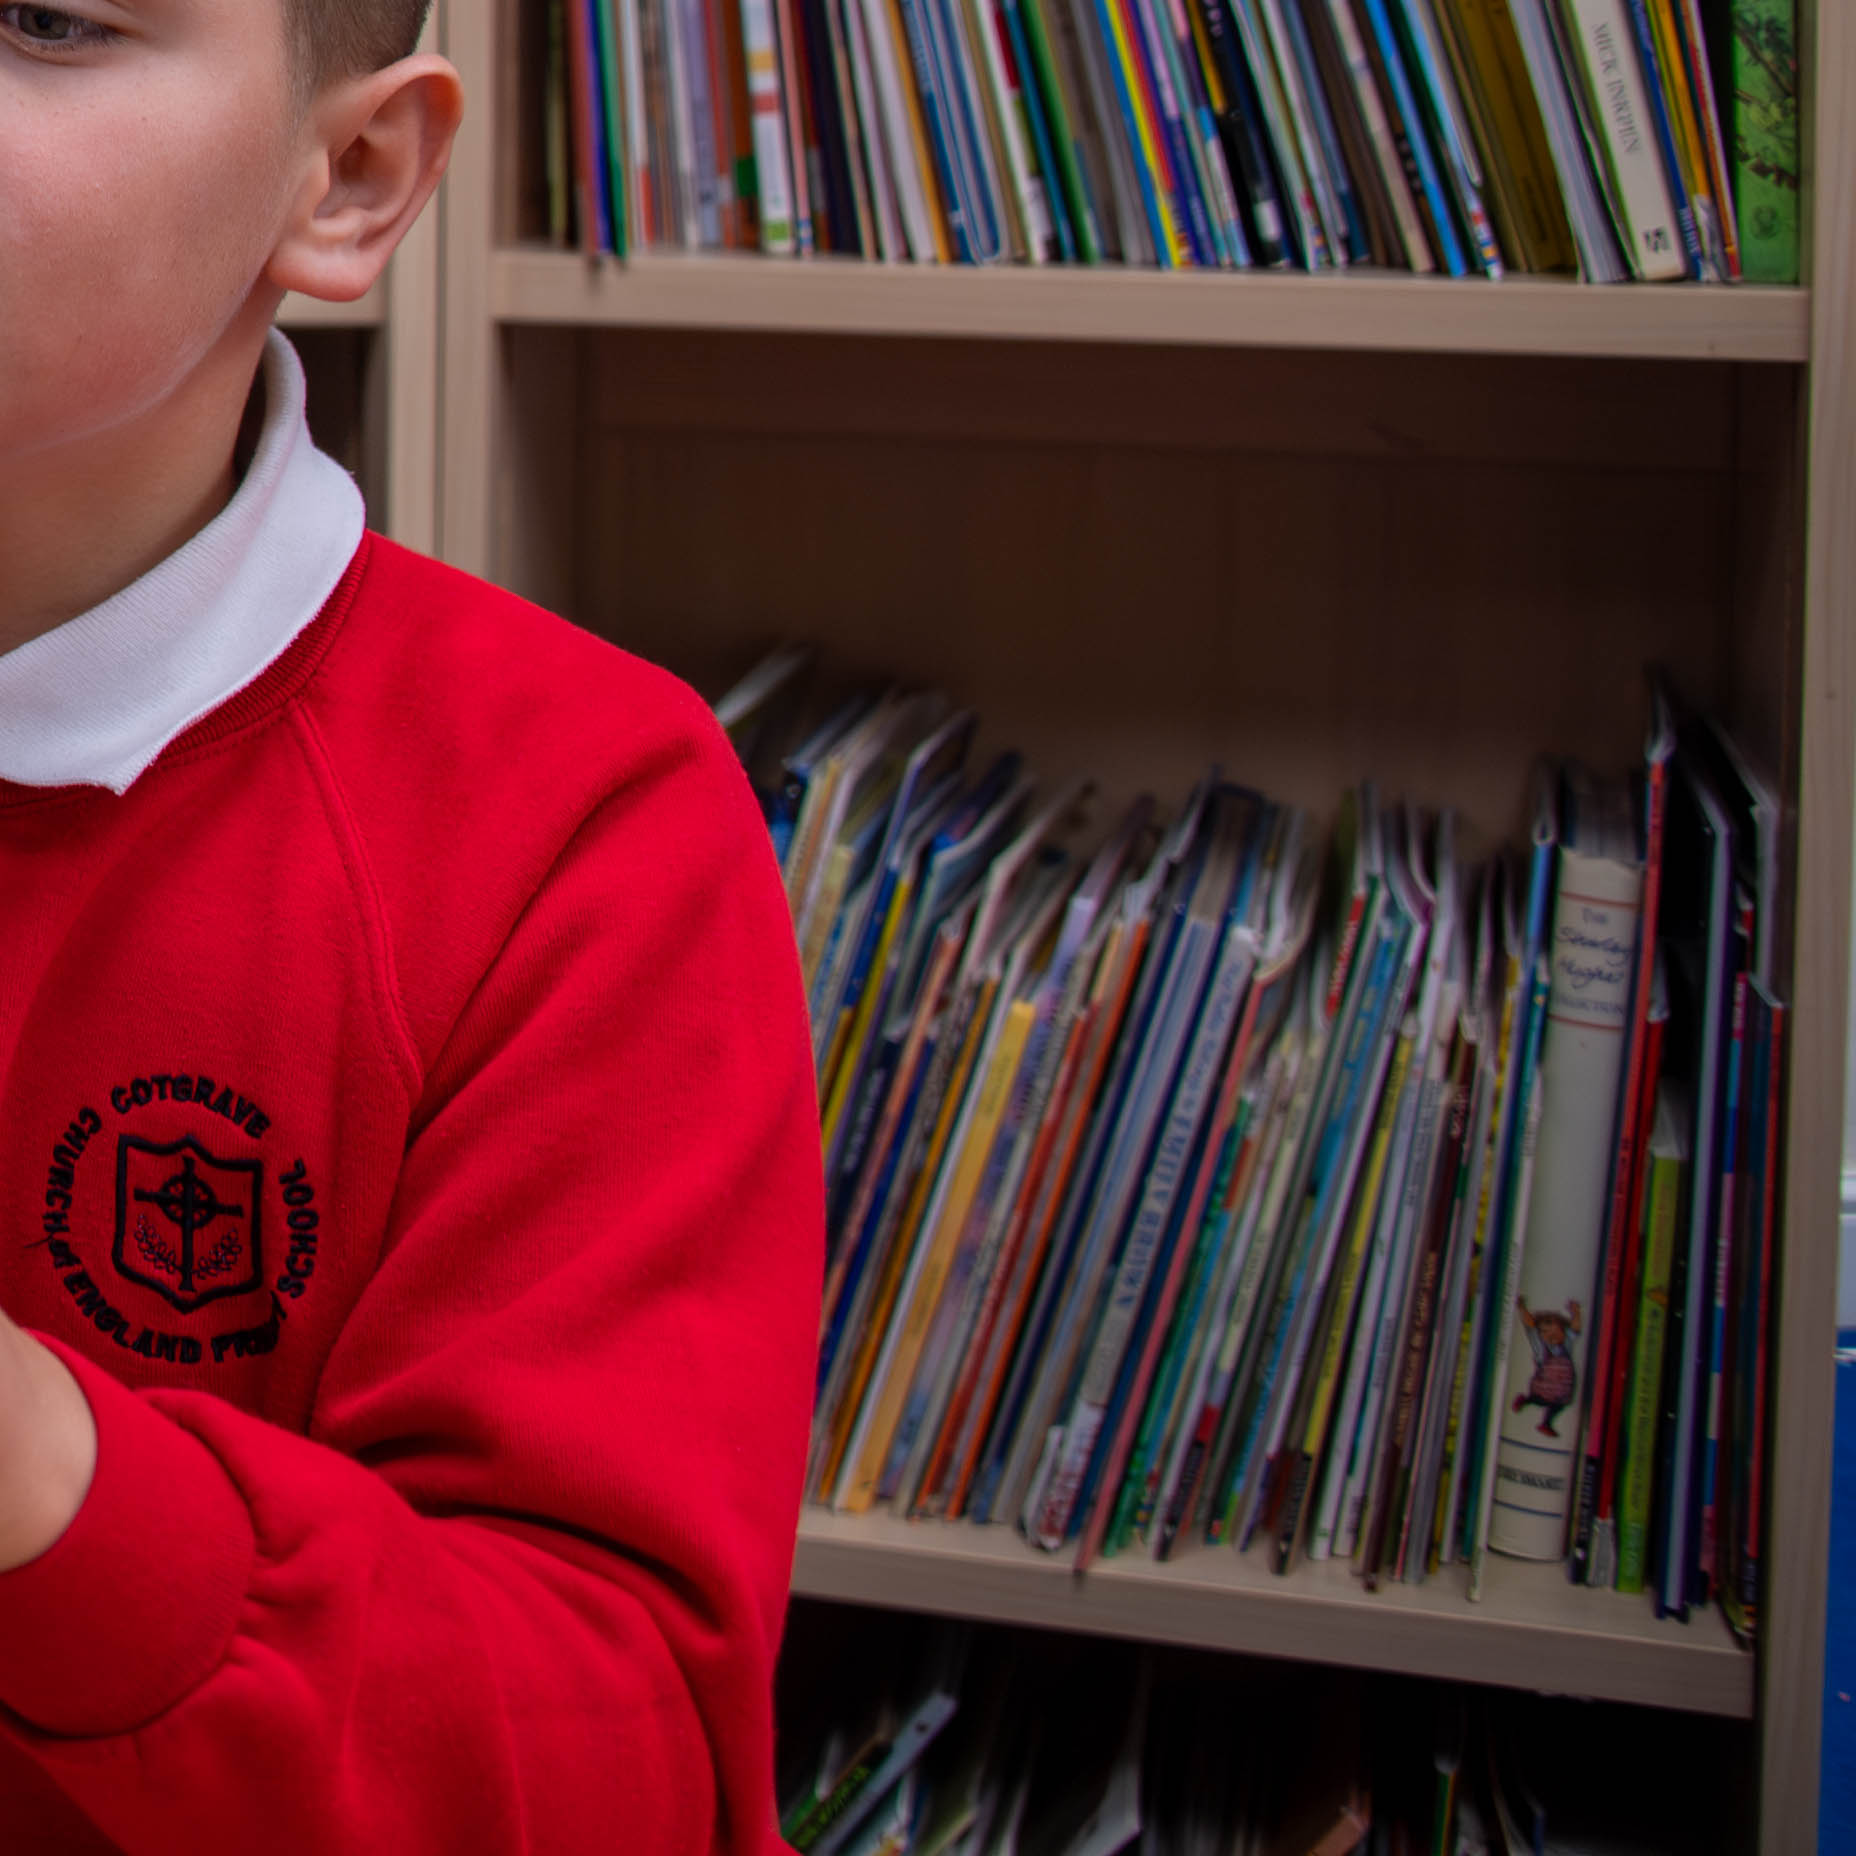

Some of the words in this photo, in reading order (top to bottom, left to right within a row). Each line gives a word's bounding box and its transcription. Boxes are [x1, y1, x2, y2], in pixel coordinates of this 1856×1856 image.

[110, 1073, 271, 1140] COTGRAVE
[42, 1106, 102, 1234] CHURCH
[276, 1157, 319, 1299] SCHOOL
[63, 1270, 203, 1365] ENGLAND
